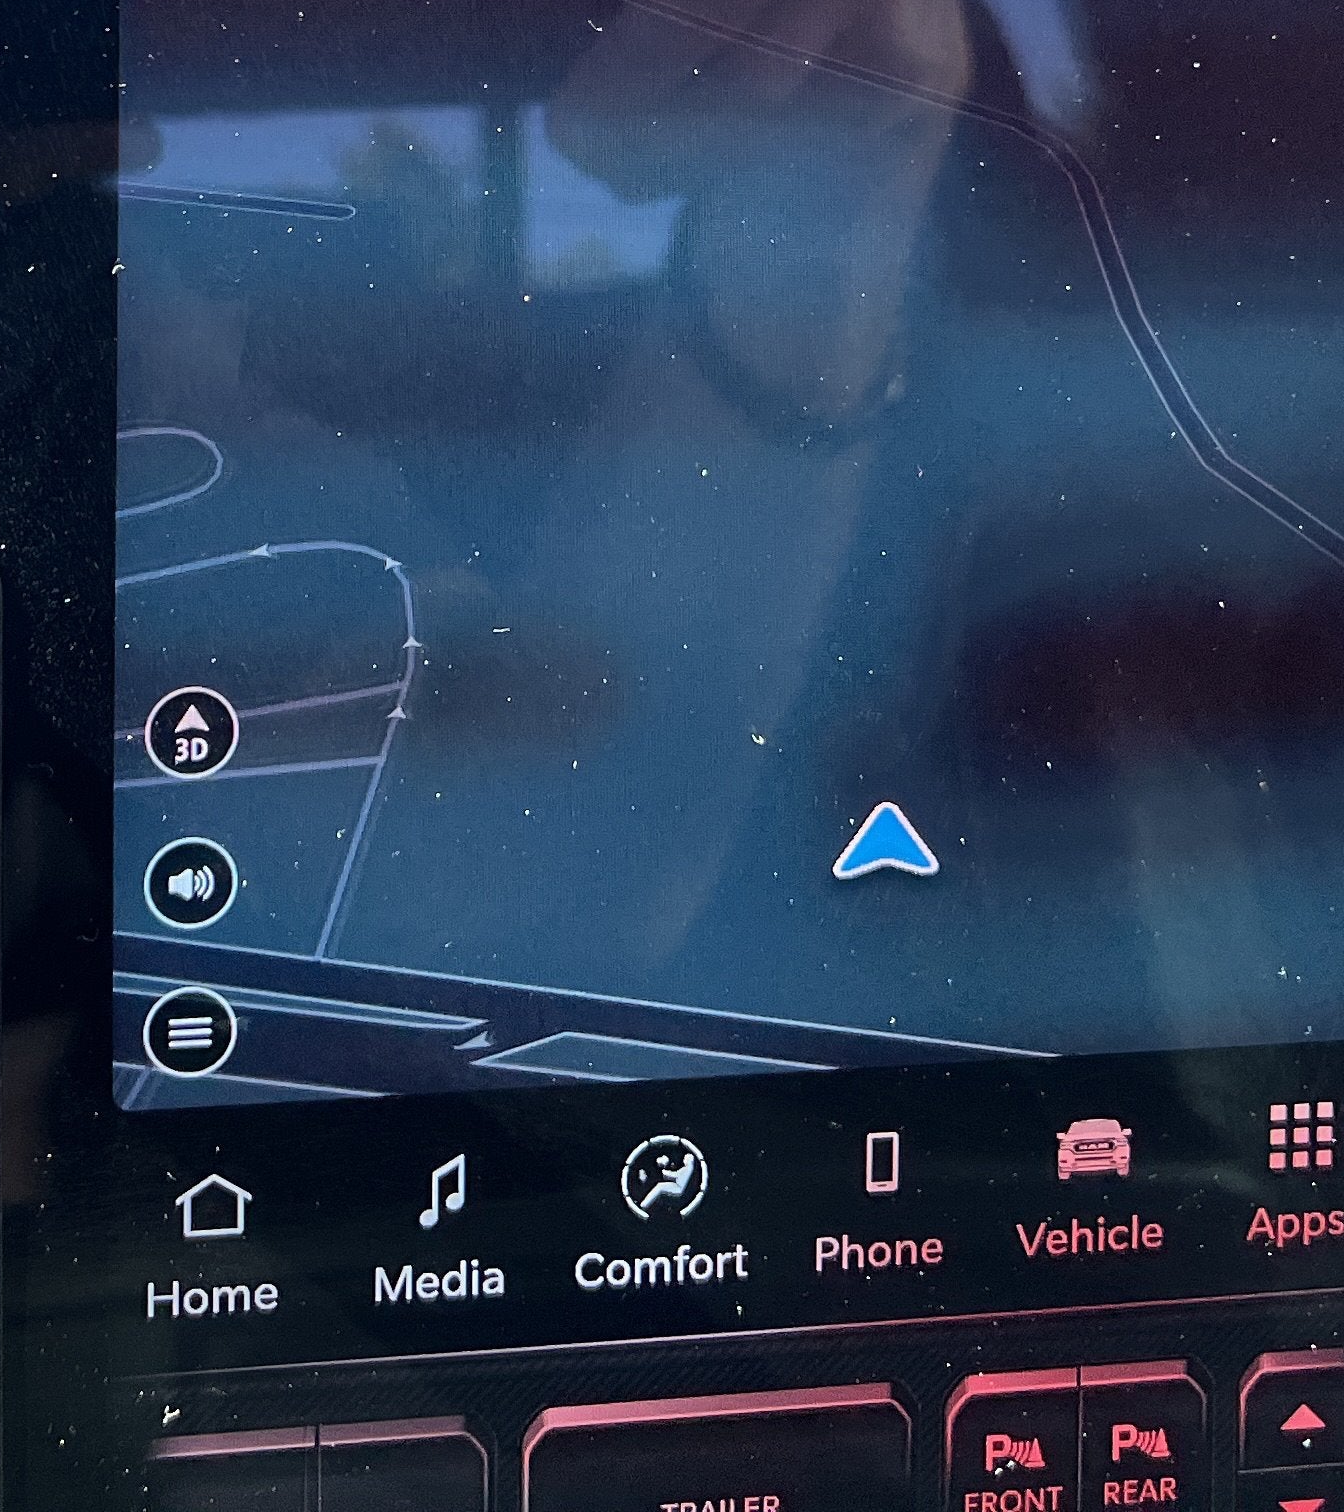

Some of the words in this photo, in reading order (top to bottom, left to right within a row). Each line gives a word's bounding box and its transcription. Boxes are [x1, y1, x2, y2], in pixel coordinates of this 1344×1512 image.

[174, 737, 208, 763] 3D
[815, 1233, 944, 1273] Phone
[1016, 1214, 1164, 1257] Vehicle
[375, 1259, 505, 1303] Media
[575, 1244, 748, 1289] Comfort
[147, 1280, 279, 1318] Home
[964, 1486, 1063, 1512] FRONT
[1104, 1477, 1177, 1506] REAR
